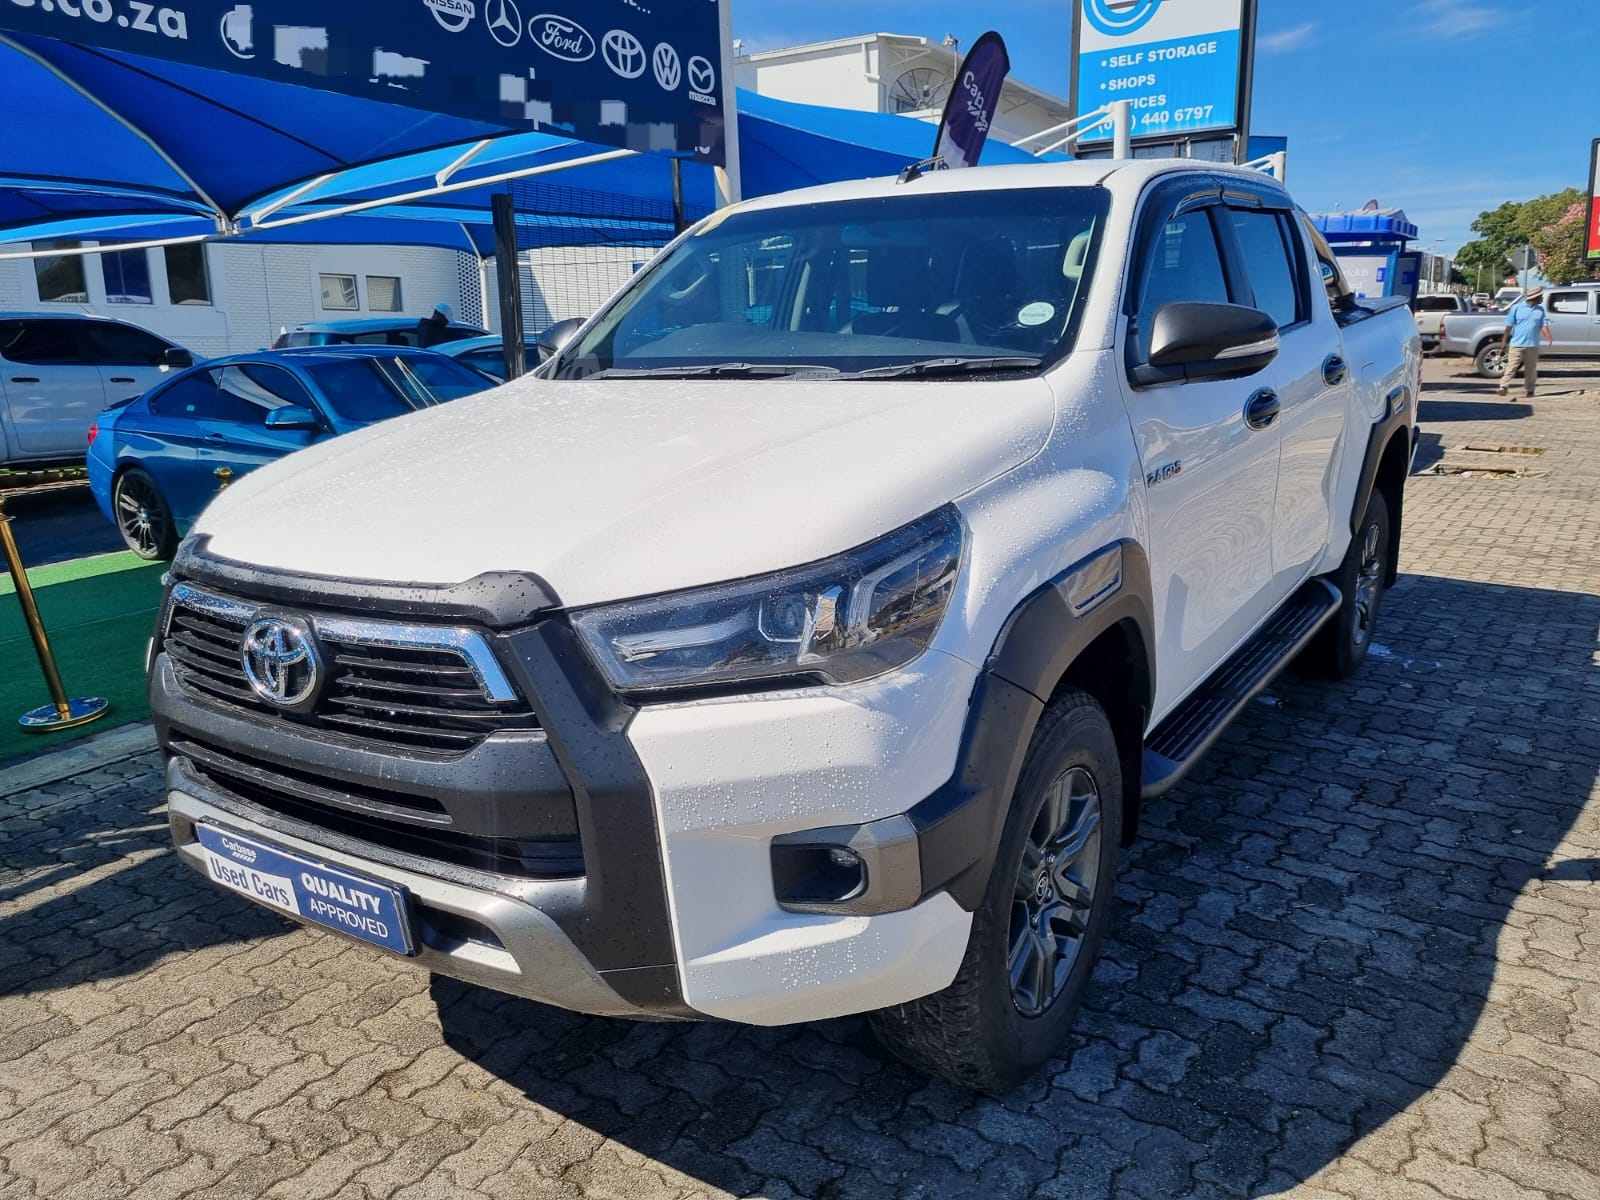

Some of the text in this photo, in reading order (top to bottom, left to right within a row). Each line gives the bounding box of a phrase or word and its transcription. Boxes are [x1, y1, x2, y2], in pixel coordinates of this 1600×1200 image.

[10, 0, 188, 40] .co.za
[541, 20, 584, 54] Ford
[1108, 41, 1217, 68] SELF STORAGE
[1108, 74, 1156, 91] SHOPS
[1141, 110, 1169, 125] 440
[1174, 105, 1214, 122] 6797
[209, 856, 291, 907] Used Cars
[300, 872, 381, 915] QUALITY
[310, 897, 389, 939] APPROVED
